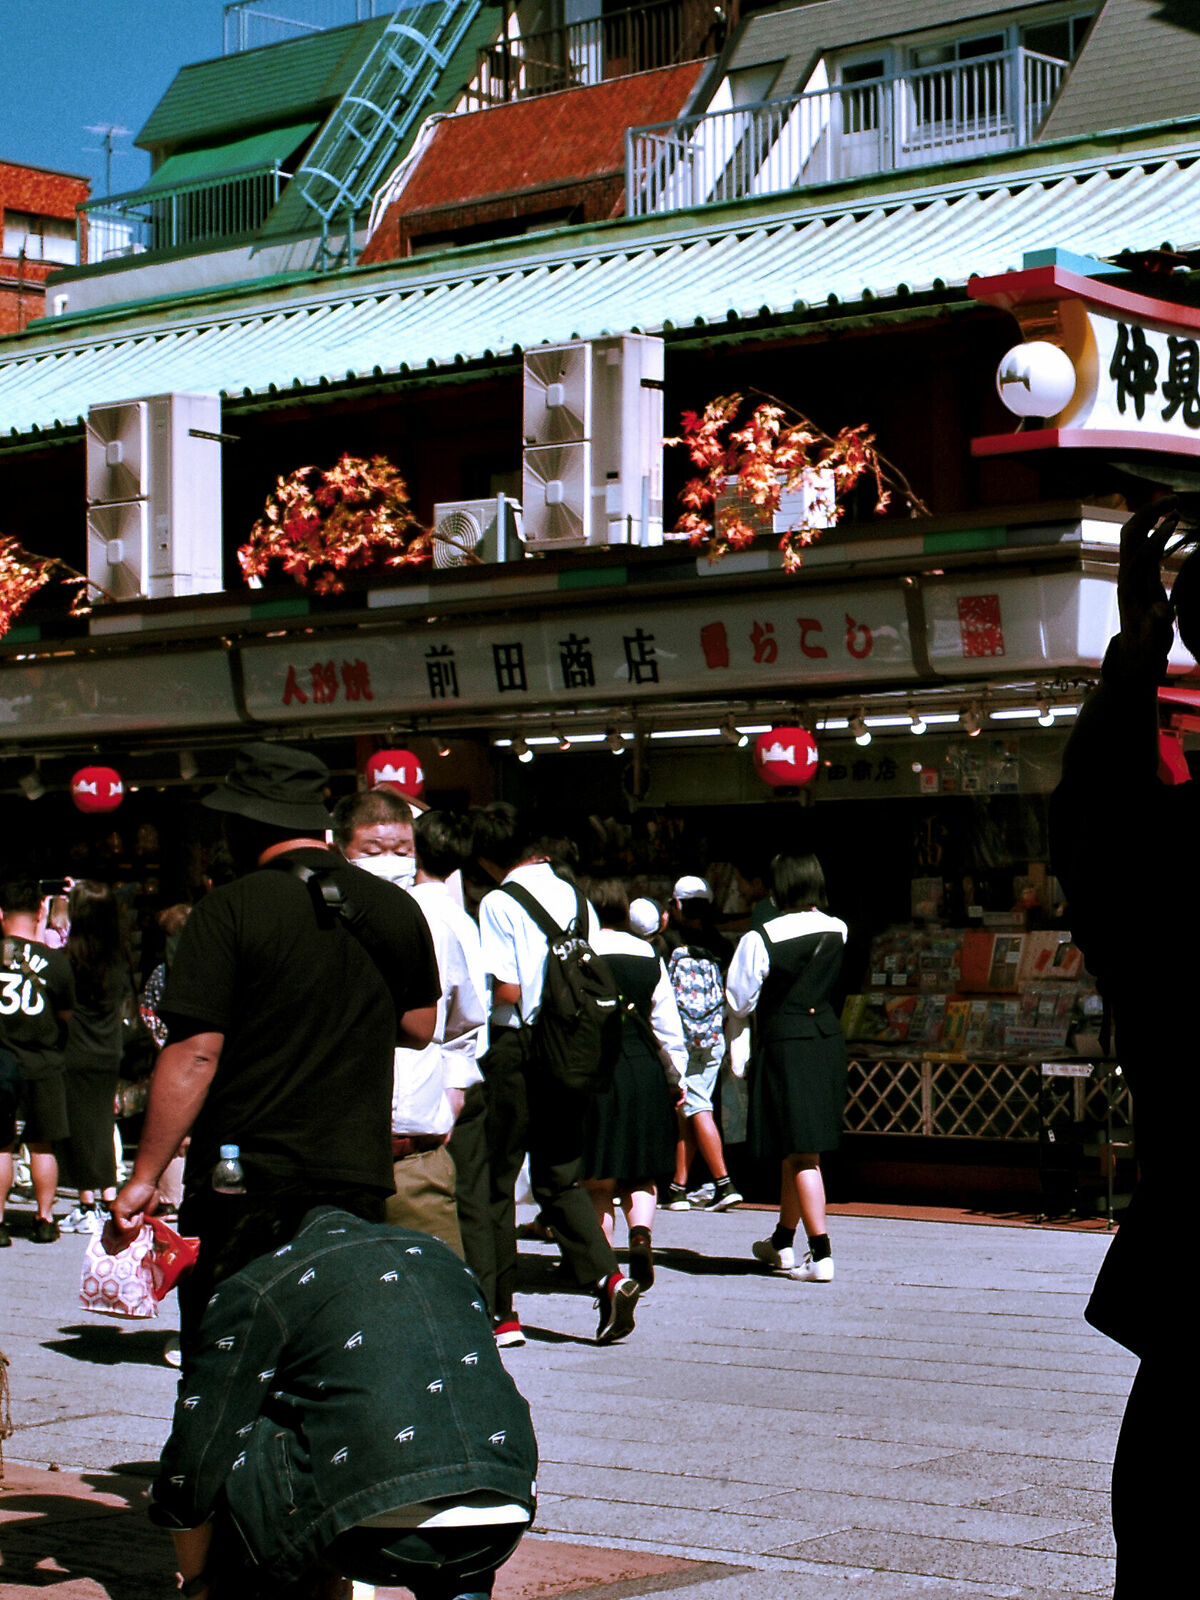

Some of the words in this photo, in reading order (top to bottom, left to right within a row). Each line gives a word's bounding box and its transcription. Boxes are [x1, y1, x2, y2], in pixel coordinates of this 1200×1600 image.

[423, 628, 661, 700] 前田商店
[0, 972, 45, 1016] 30
